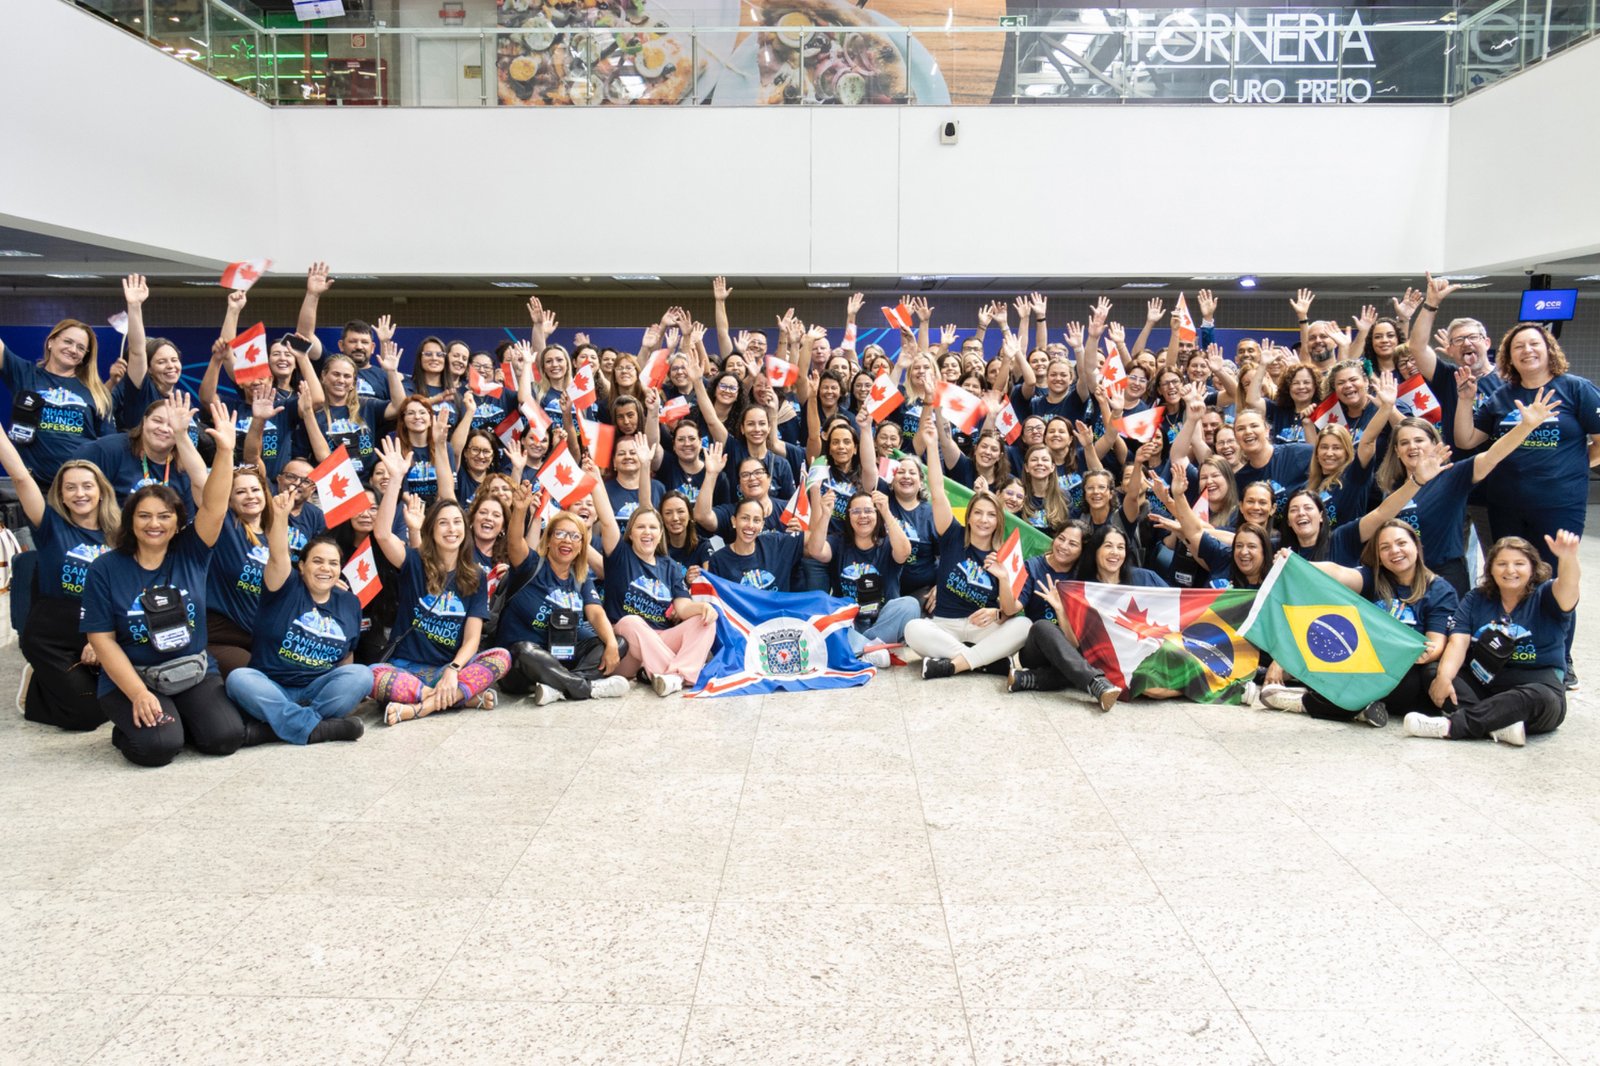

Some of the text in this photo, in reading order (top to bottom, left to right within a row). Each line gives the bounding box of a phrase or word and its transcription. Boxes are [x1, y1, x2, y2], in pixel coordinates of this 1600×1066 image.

[1131, 9, 1374, 64] FORNERIA
[1298, 79, 1372, 103] PRETO
[42, 407, 84, 420] NHANDO
[39, 421, 84, 434] OFESSOR
[282, 639, 338, 663] O MUNDO
[285, 630, 343, 656] GANHANDO
